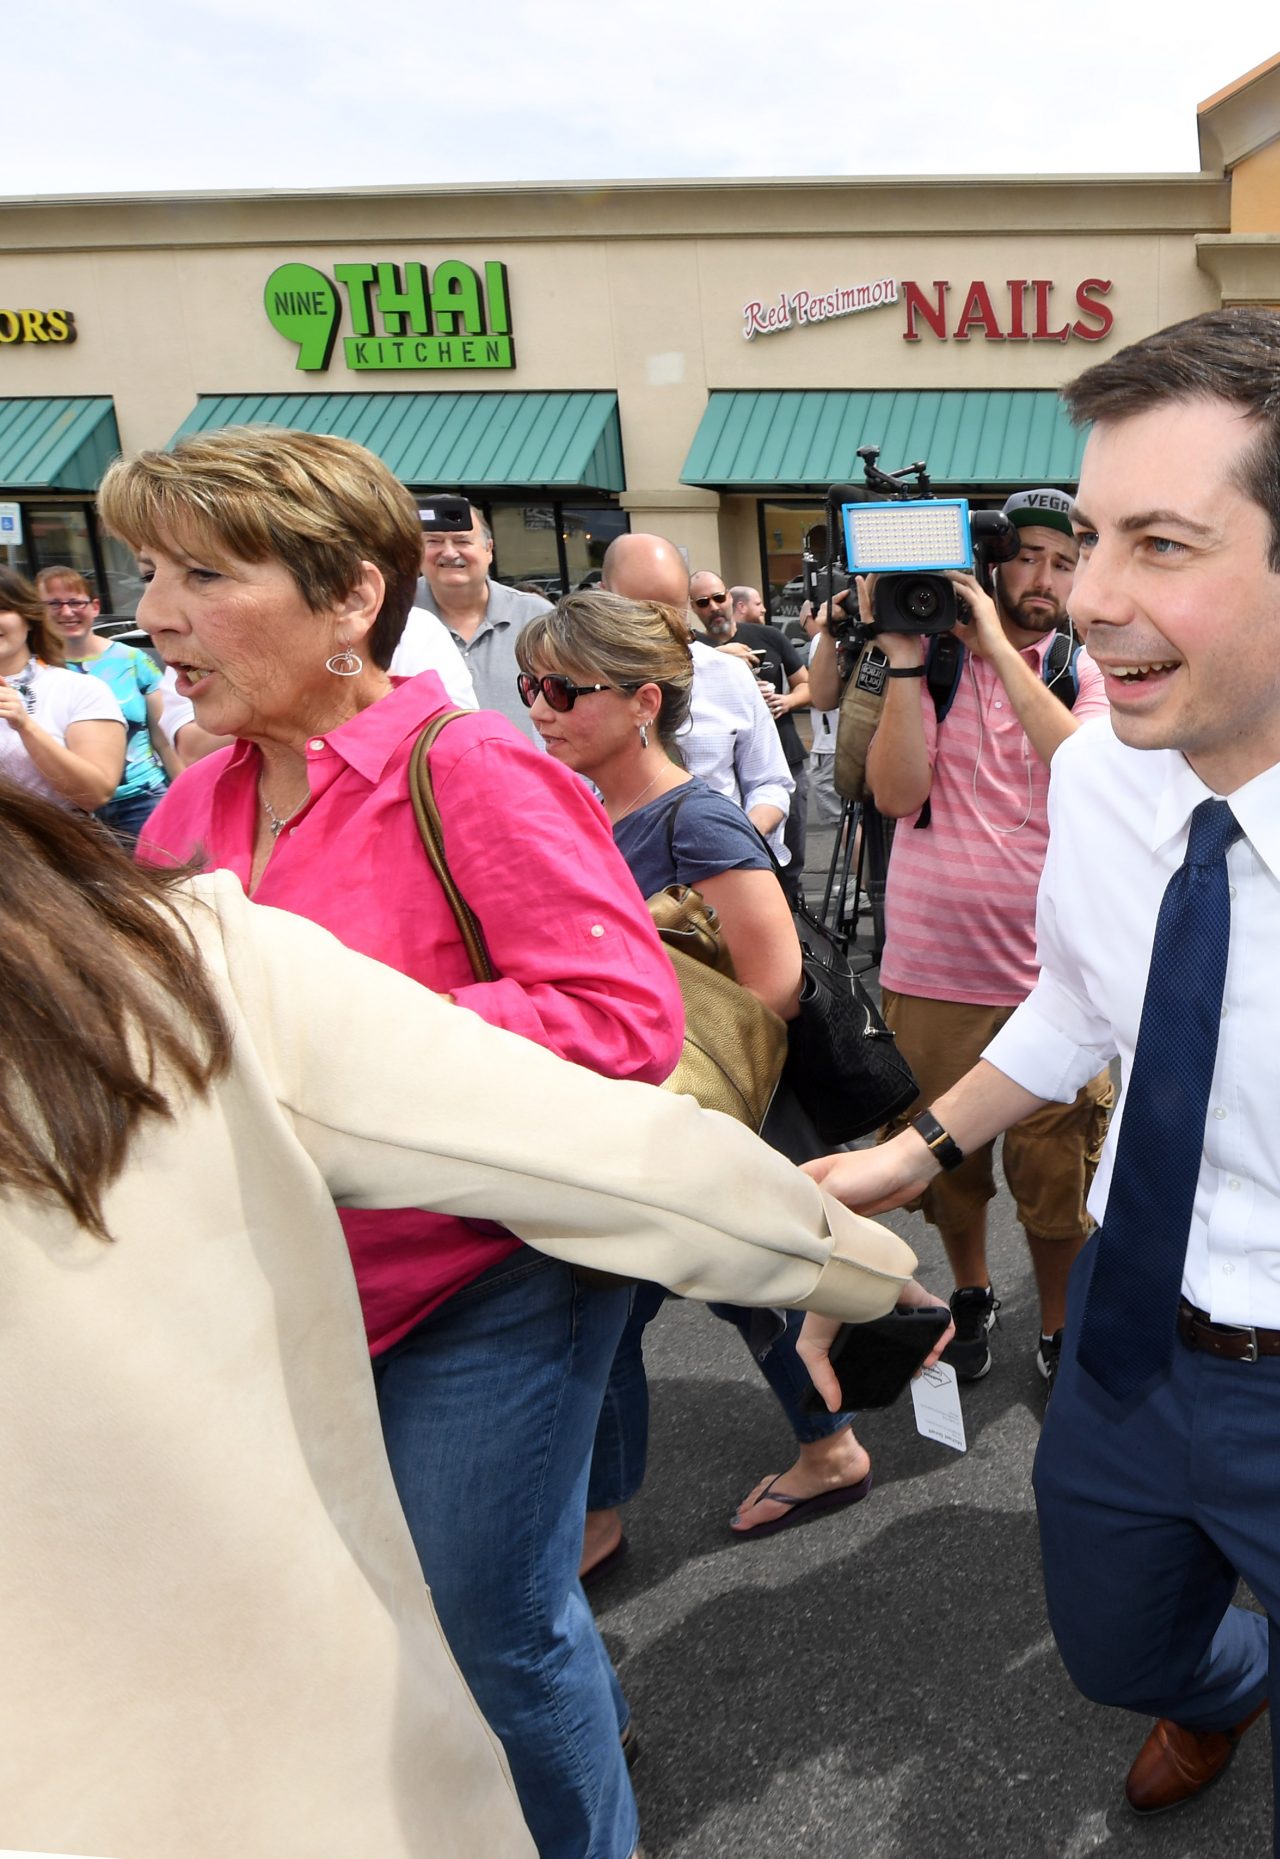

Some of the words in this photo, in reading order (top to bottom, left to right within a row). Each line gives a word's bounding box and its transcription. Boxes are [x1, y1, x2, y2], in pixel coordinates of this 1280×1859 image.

[274, 291, 328, 316] NINE
[333, 260, 510, 335] THAI
[744, 293, 791, 338] Red
[792, 278, 897, 323] Persimmon
[901, 278, 1114, 342] NAILS
[355, 340, 500, 364] KITCHEN
[780, 605, 803, 616] WA
